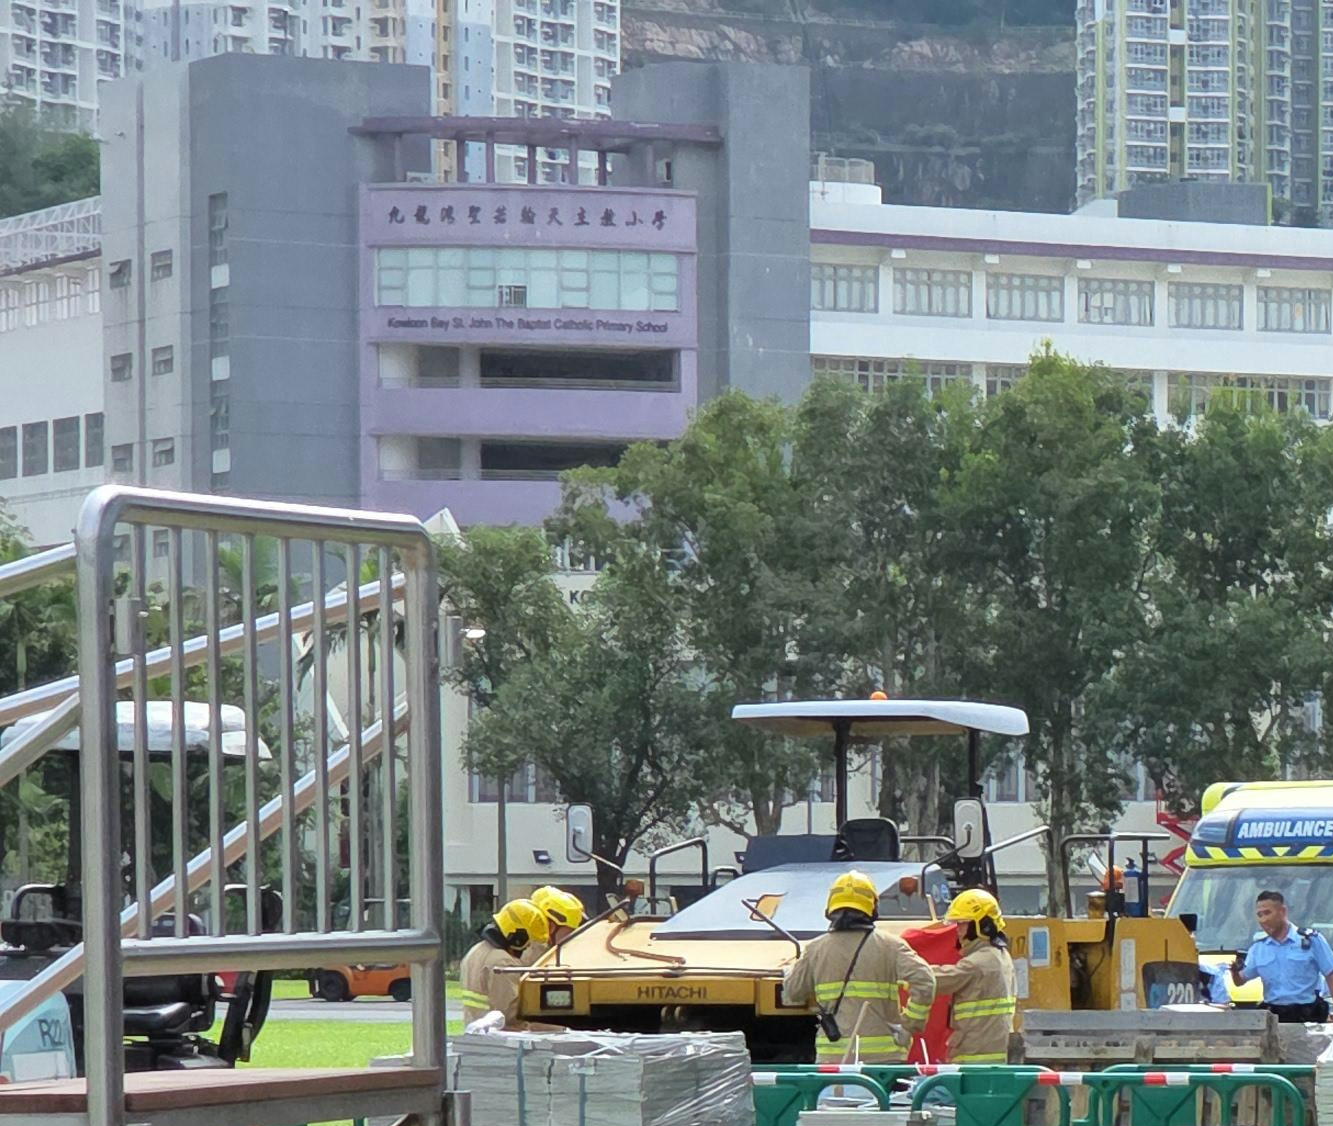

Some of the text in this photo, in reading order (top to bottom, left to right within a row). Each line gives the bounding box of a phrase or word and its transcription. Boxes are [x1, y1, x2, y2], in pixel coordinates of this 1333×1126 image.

[387, 317, 428, 329] Kowloon
[430, 317, 450, 331] Bay
[469, 318, 493, 329] John
[495, 318, 515, 329] The
[518, 318, 551, 332] Baptist
[554, 318, 593, 331] Catholic
[596, 319, 633, 334] Primary
[636, 321, 668, 333] School
[637, 986, 708, 999] HITACHI
